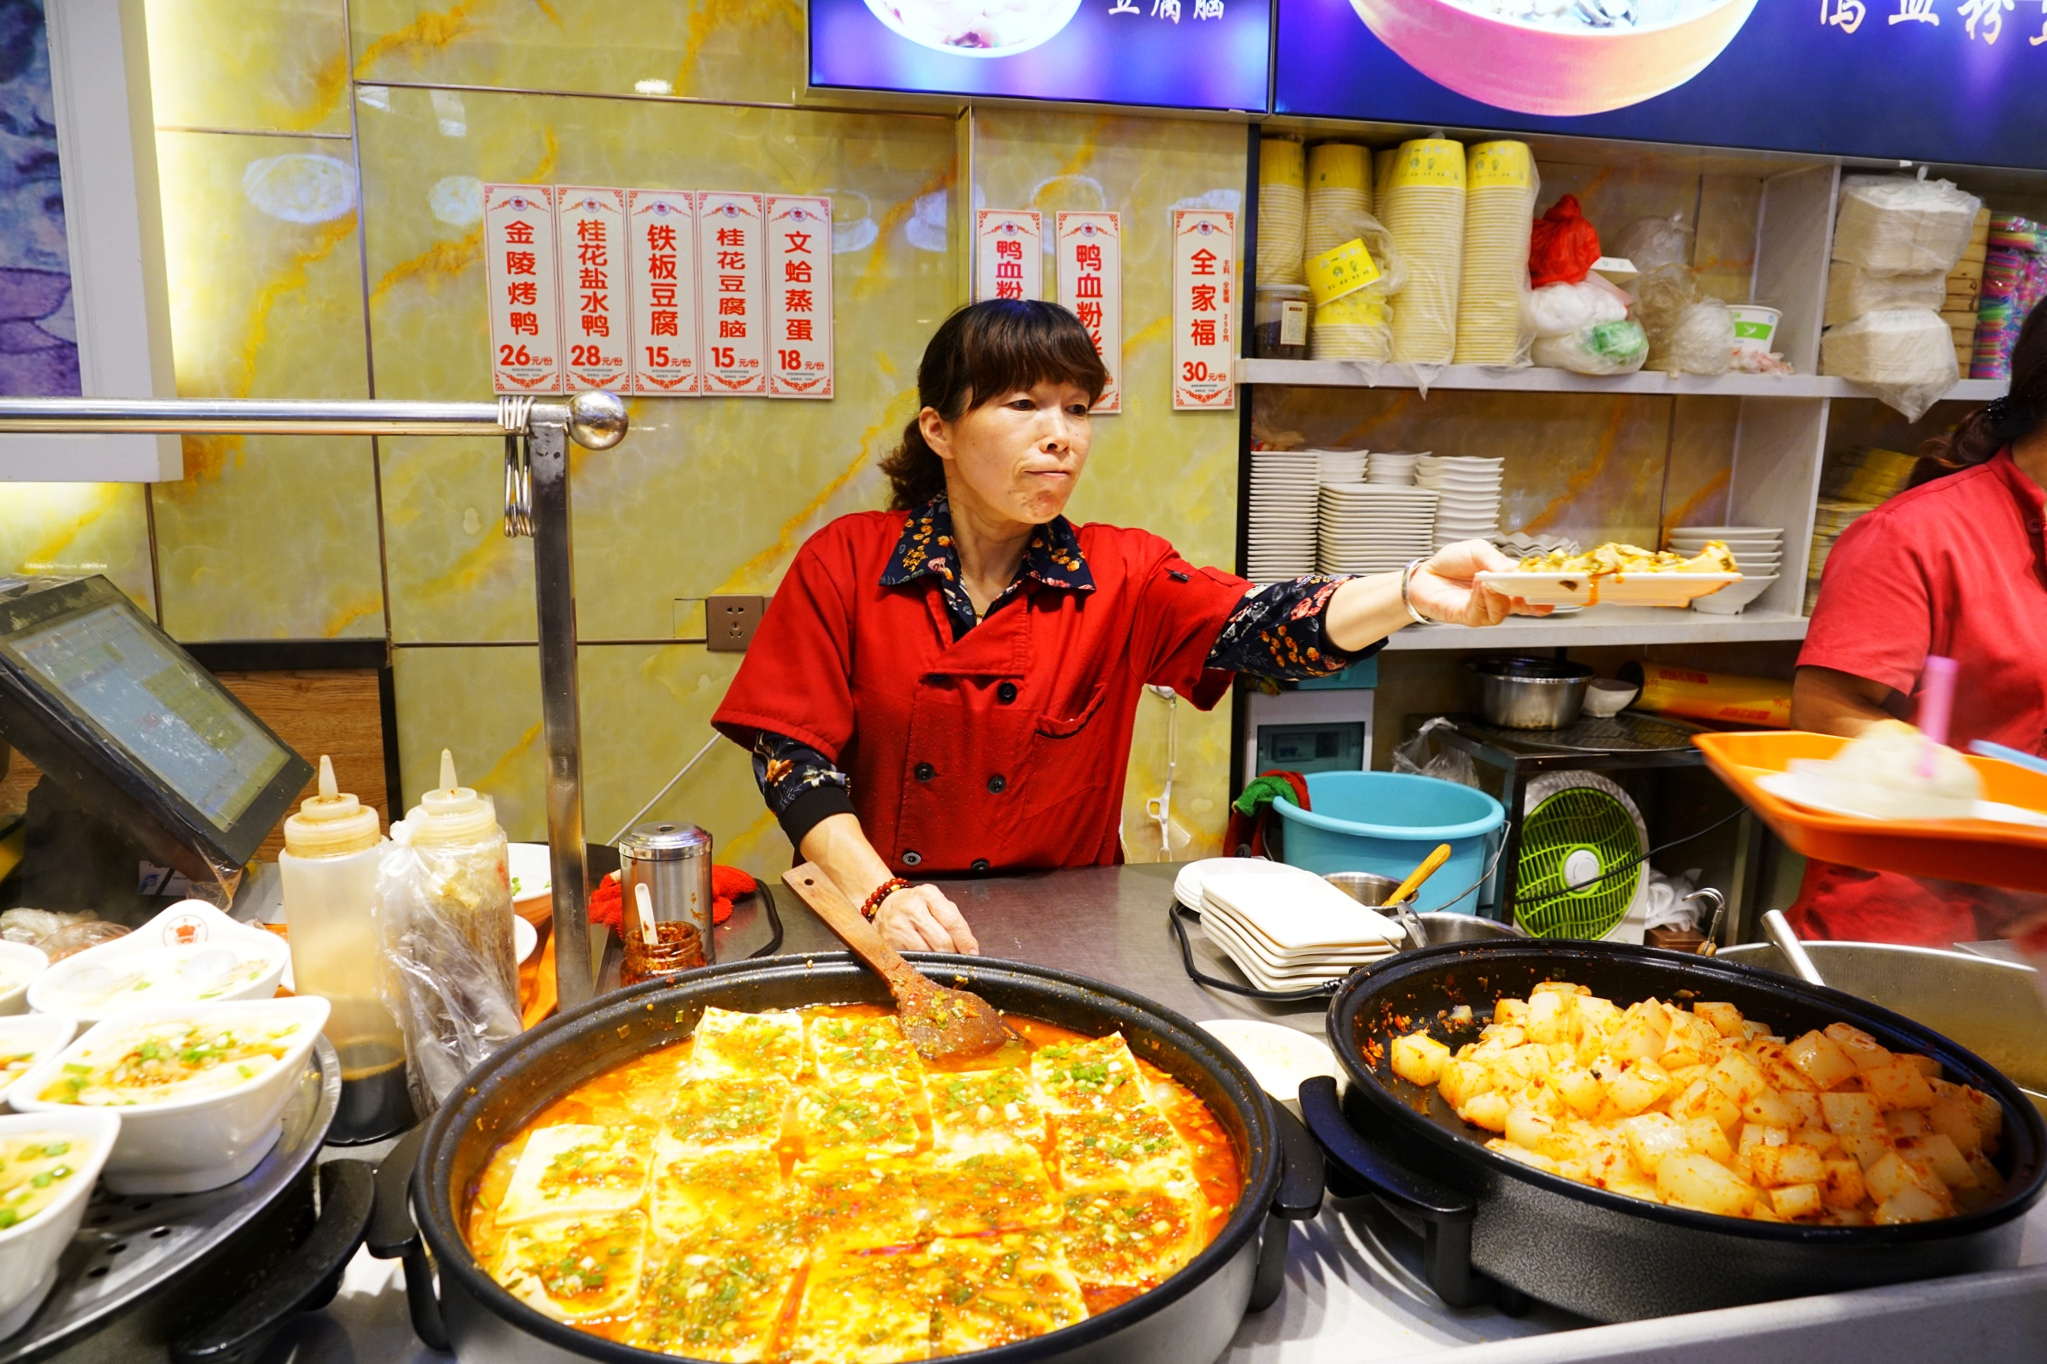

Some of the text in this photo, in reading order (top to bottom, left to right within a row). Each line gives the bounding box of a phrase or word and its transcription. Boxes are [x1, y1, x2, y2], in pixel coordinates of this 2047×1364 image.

[504, 219, 539, 337] 金陵烤鸭
[576, 219, 610, 338] 桂花盐水鸭
[647, 223, 679, 337] 铁板豆腐
[716, 227, 747, 339] 桂花豆腐脑
[784, 230, 813, 342] 文蛤蒸蛋
[1190, 247, 1217, 346] 全家福
[499, 343, 553, 367] 26元/份
[570, 344, 623, 367] 28元/份
[1182, 360, 1227, 382] 30元/份
